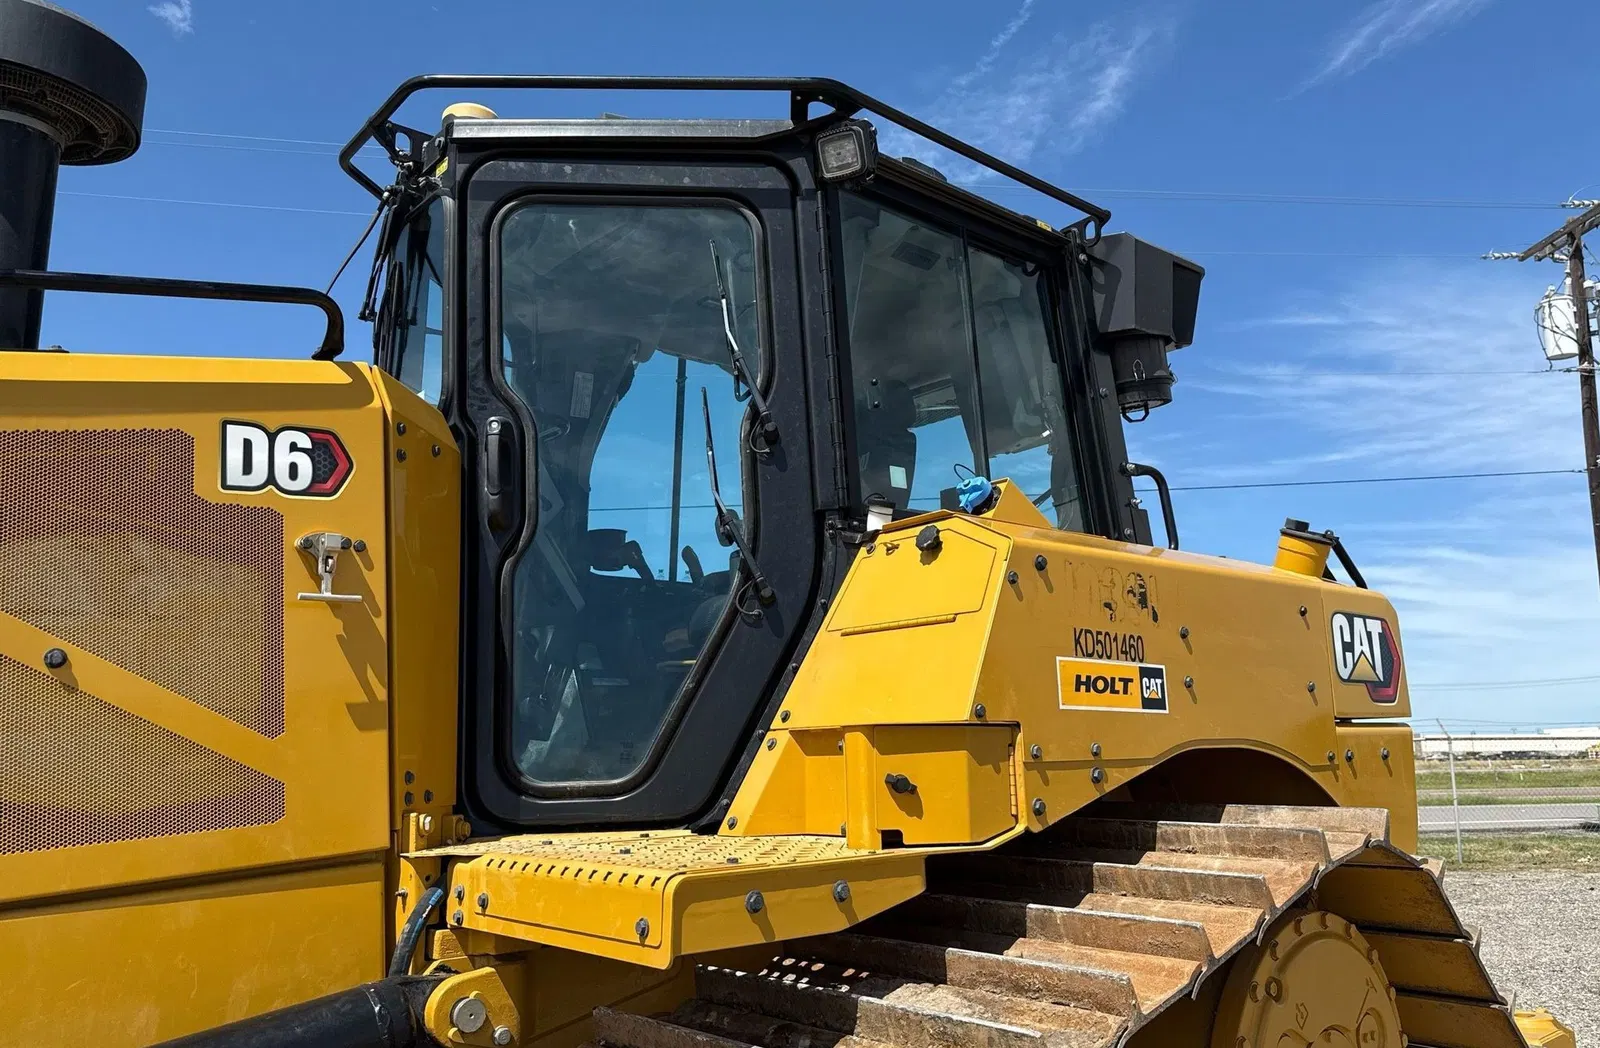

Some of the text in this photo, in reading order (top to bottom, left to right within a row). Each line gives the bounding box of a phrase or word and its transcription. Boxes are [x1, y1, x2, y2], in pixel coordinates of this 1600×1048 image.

[226, 424, 313, 491] D6
[1073, 627, 1145, 663] KD501460
[1332, 613, 1384, 682] CAT
[1074, 674, 1163, 699] HOLT CAT
